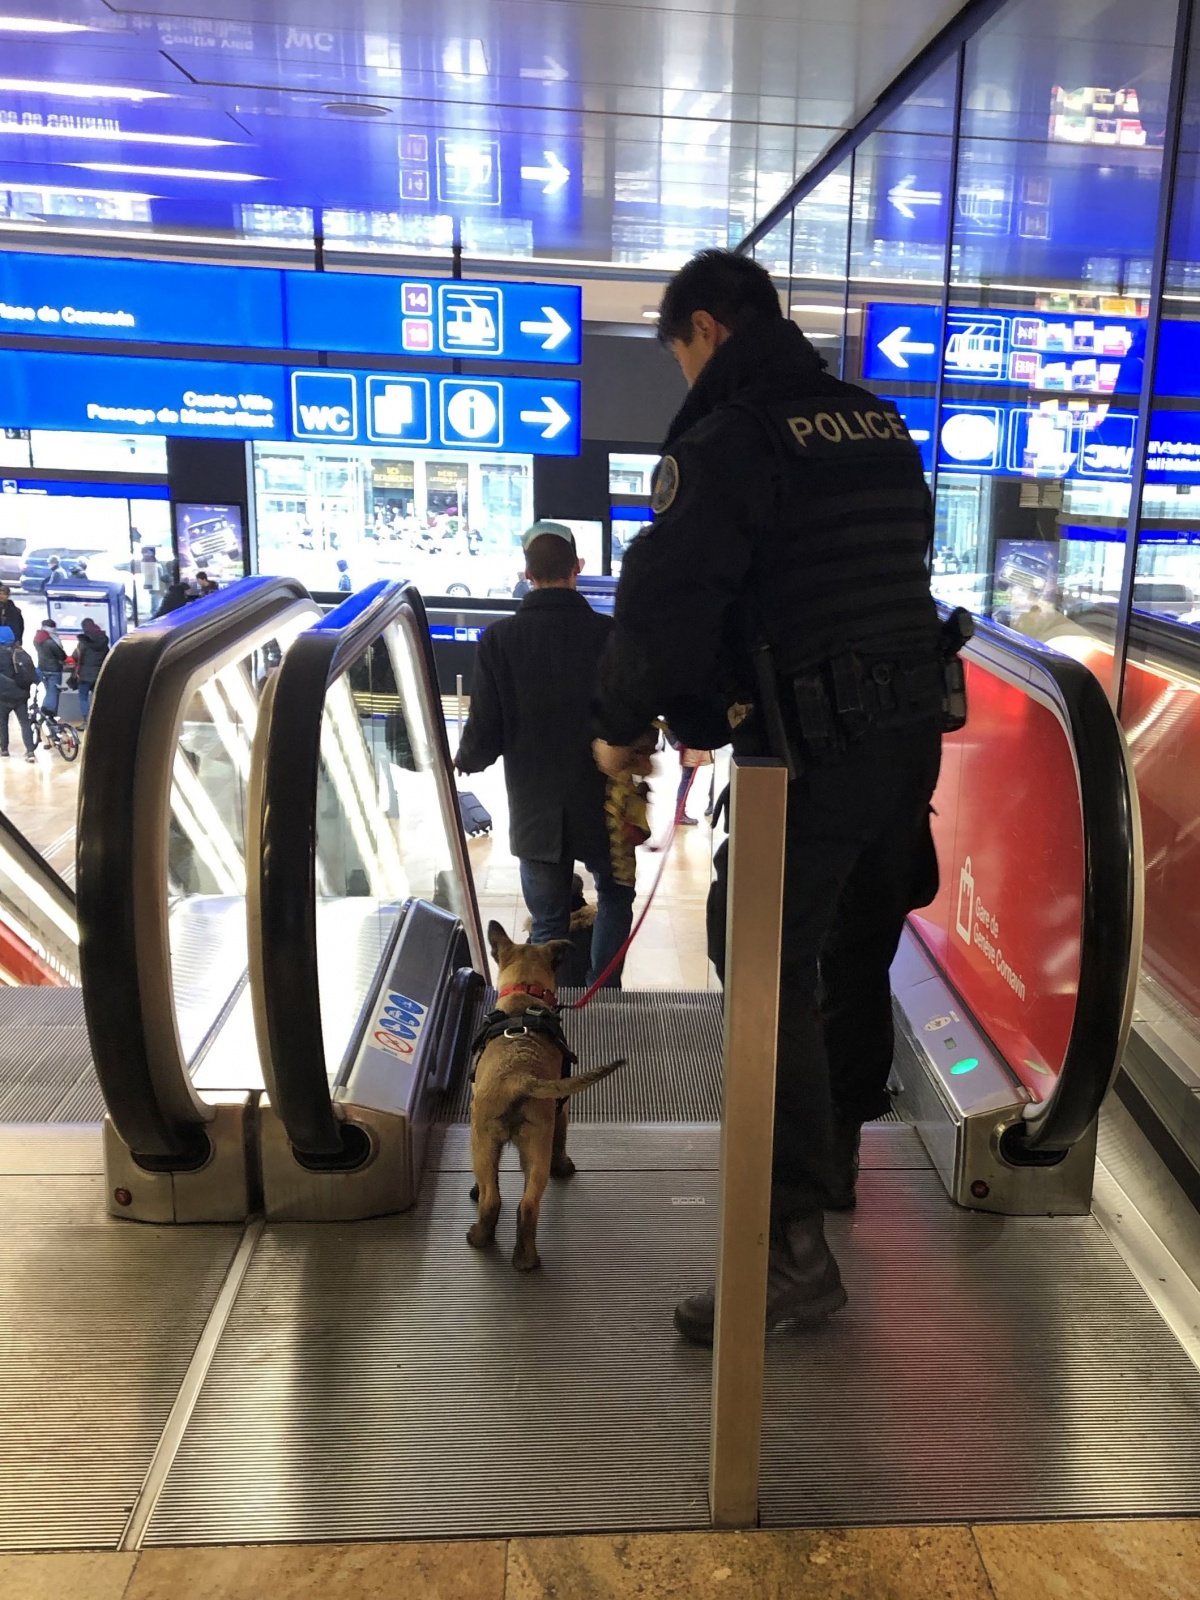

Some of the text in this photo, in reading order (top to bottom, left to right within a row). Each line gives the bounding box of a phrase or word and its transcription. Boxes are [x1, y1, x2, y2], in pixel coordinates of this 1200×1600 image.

[407, 292, 427, 307] 14
[299, 404, 350, 432] WC
[786, 410, 909, 448] POLICE
[975, 896, 999, 939] Gare de
